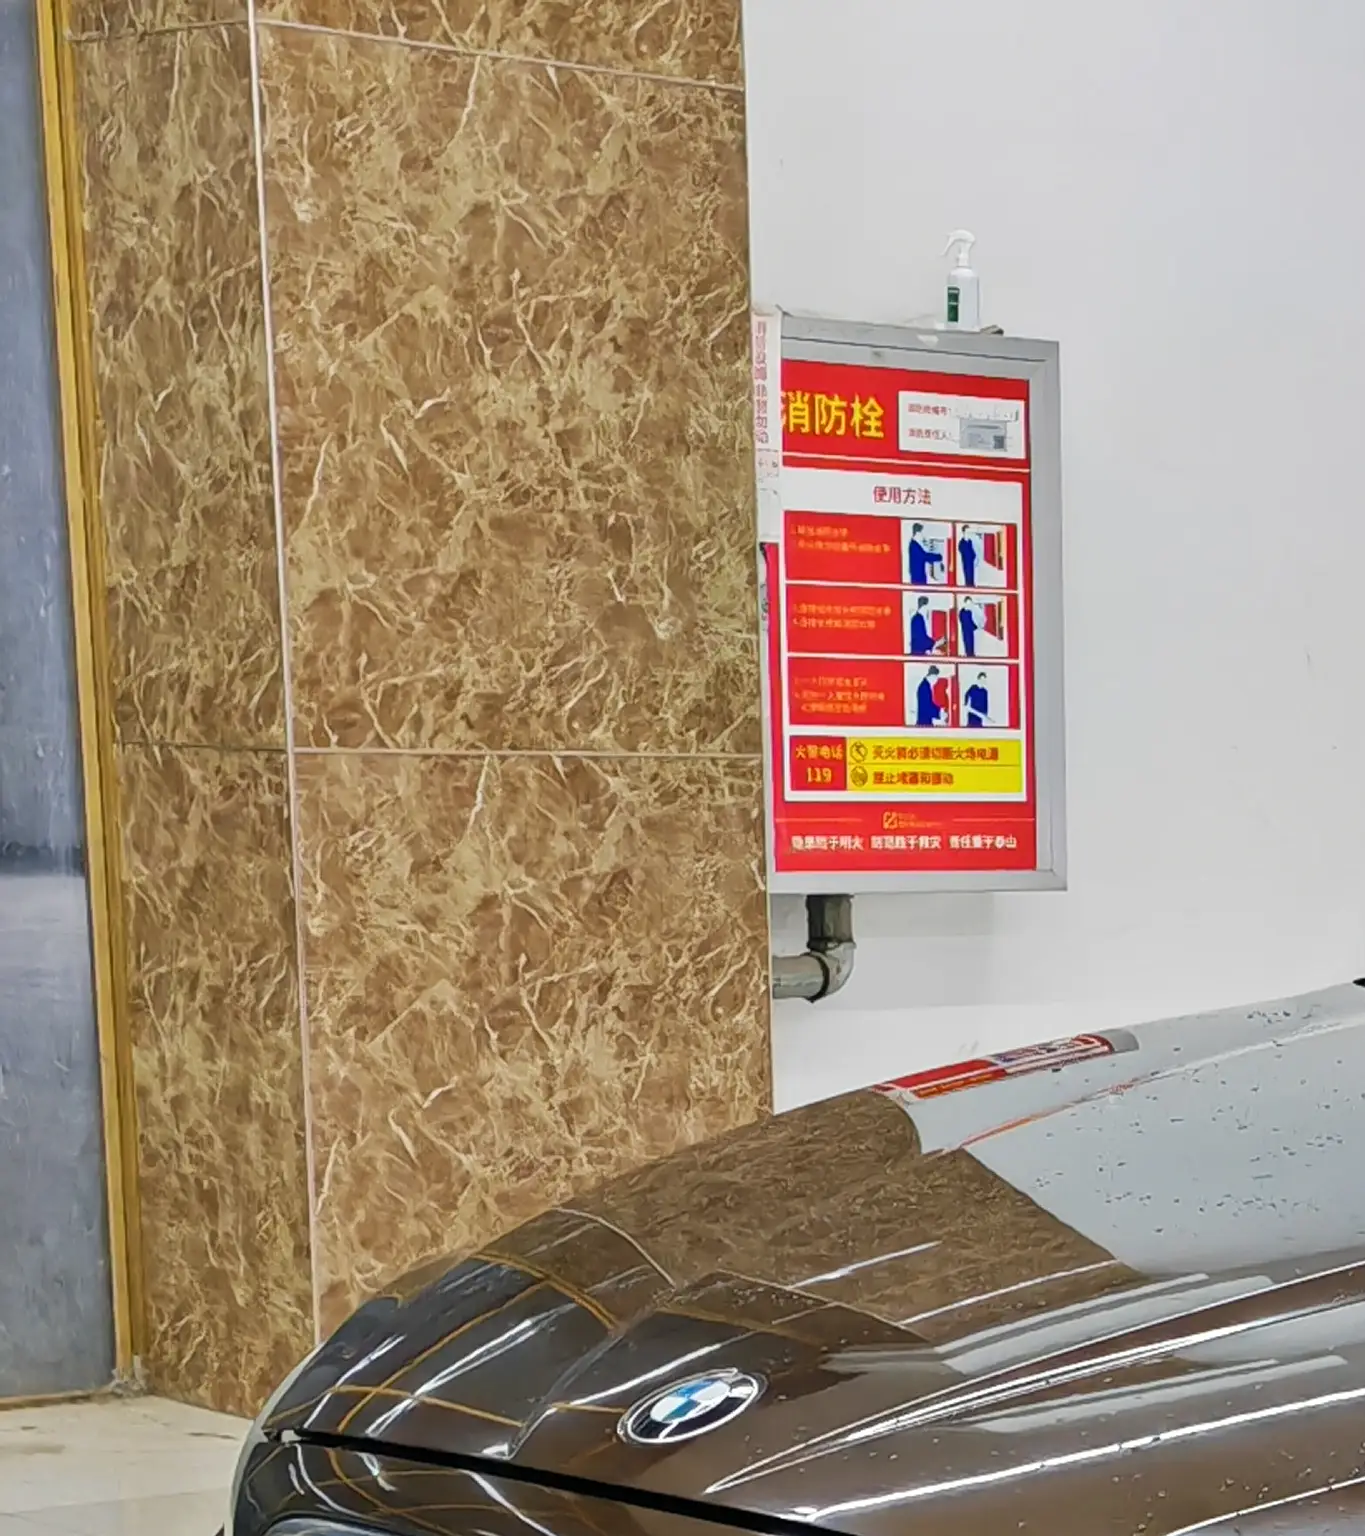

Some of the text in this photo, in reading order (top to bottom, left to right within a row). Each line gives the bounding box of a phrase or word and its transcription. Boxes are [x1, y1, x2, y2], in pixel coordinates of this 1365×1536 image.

[781, 390, 885, 438] 消防栓
[873, 485, 932, 505] 使用方法
[807, 768, 832, 783] 119
